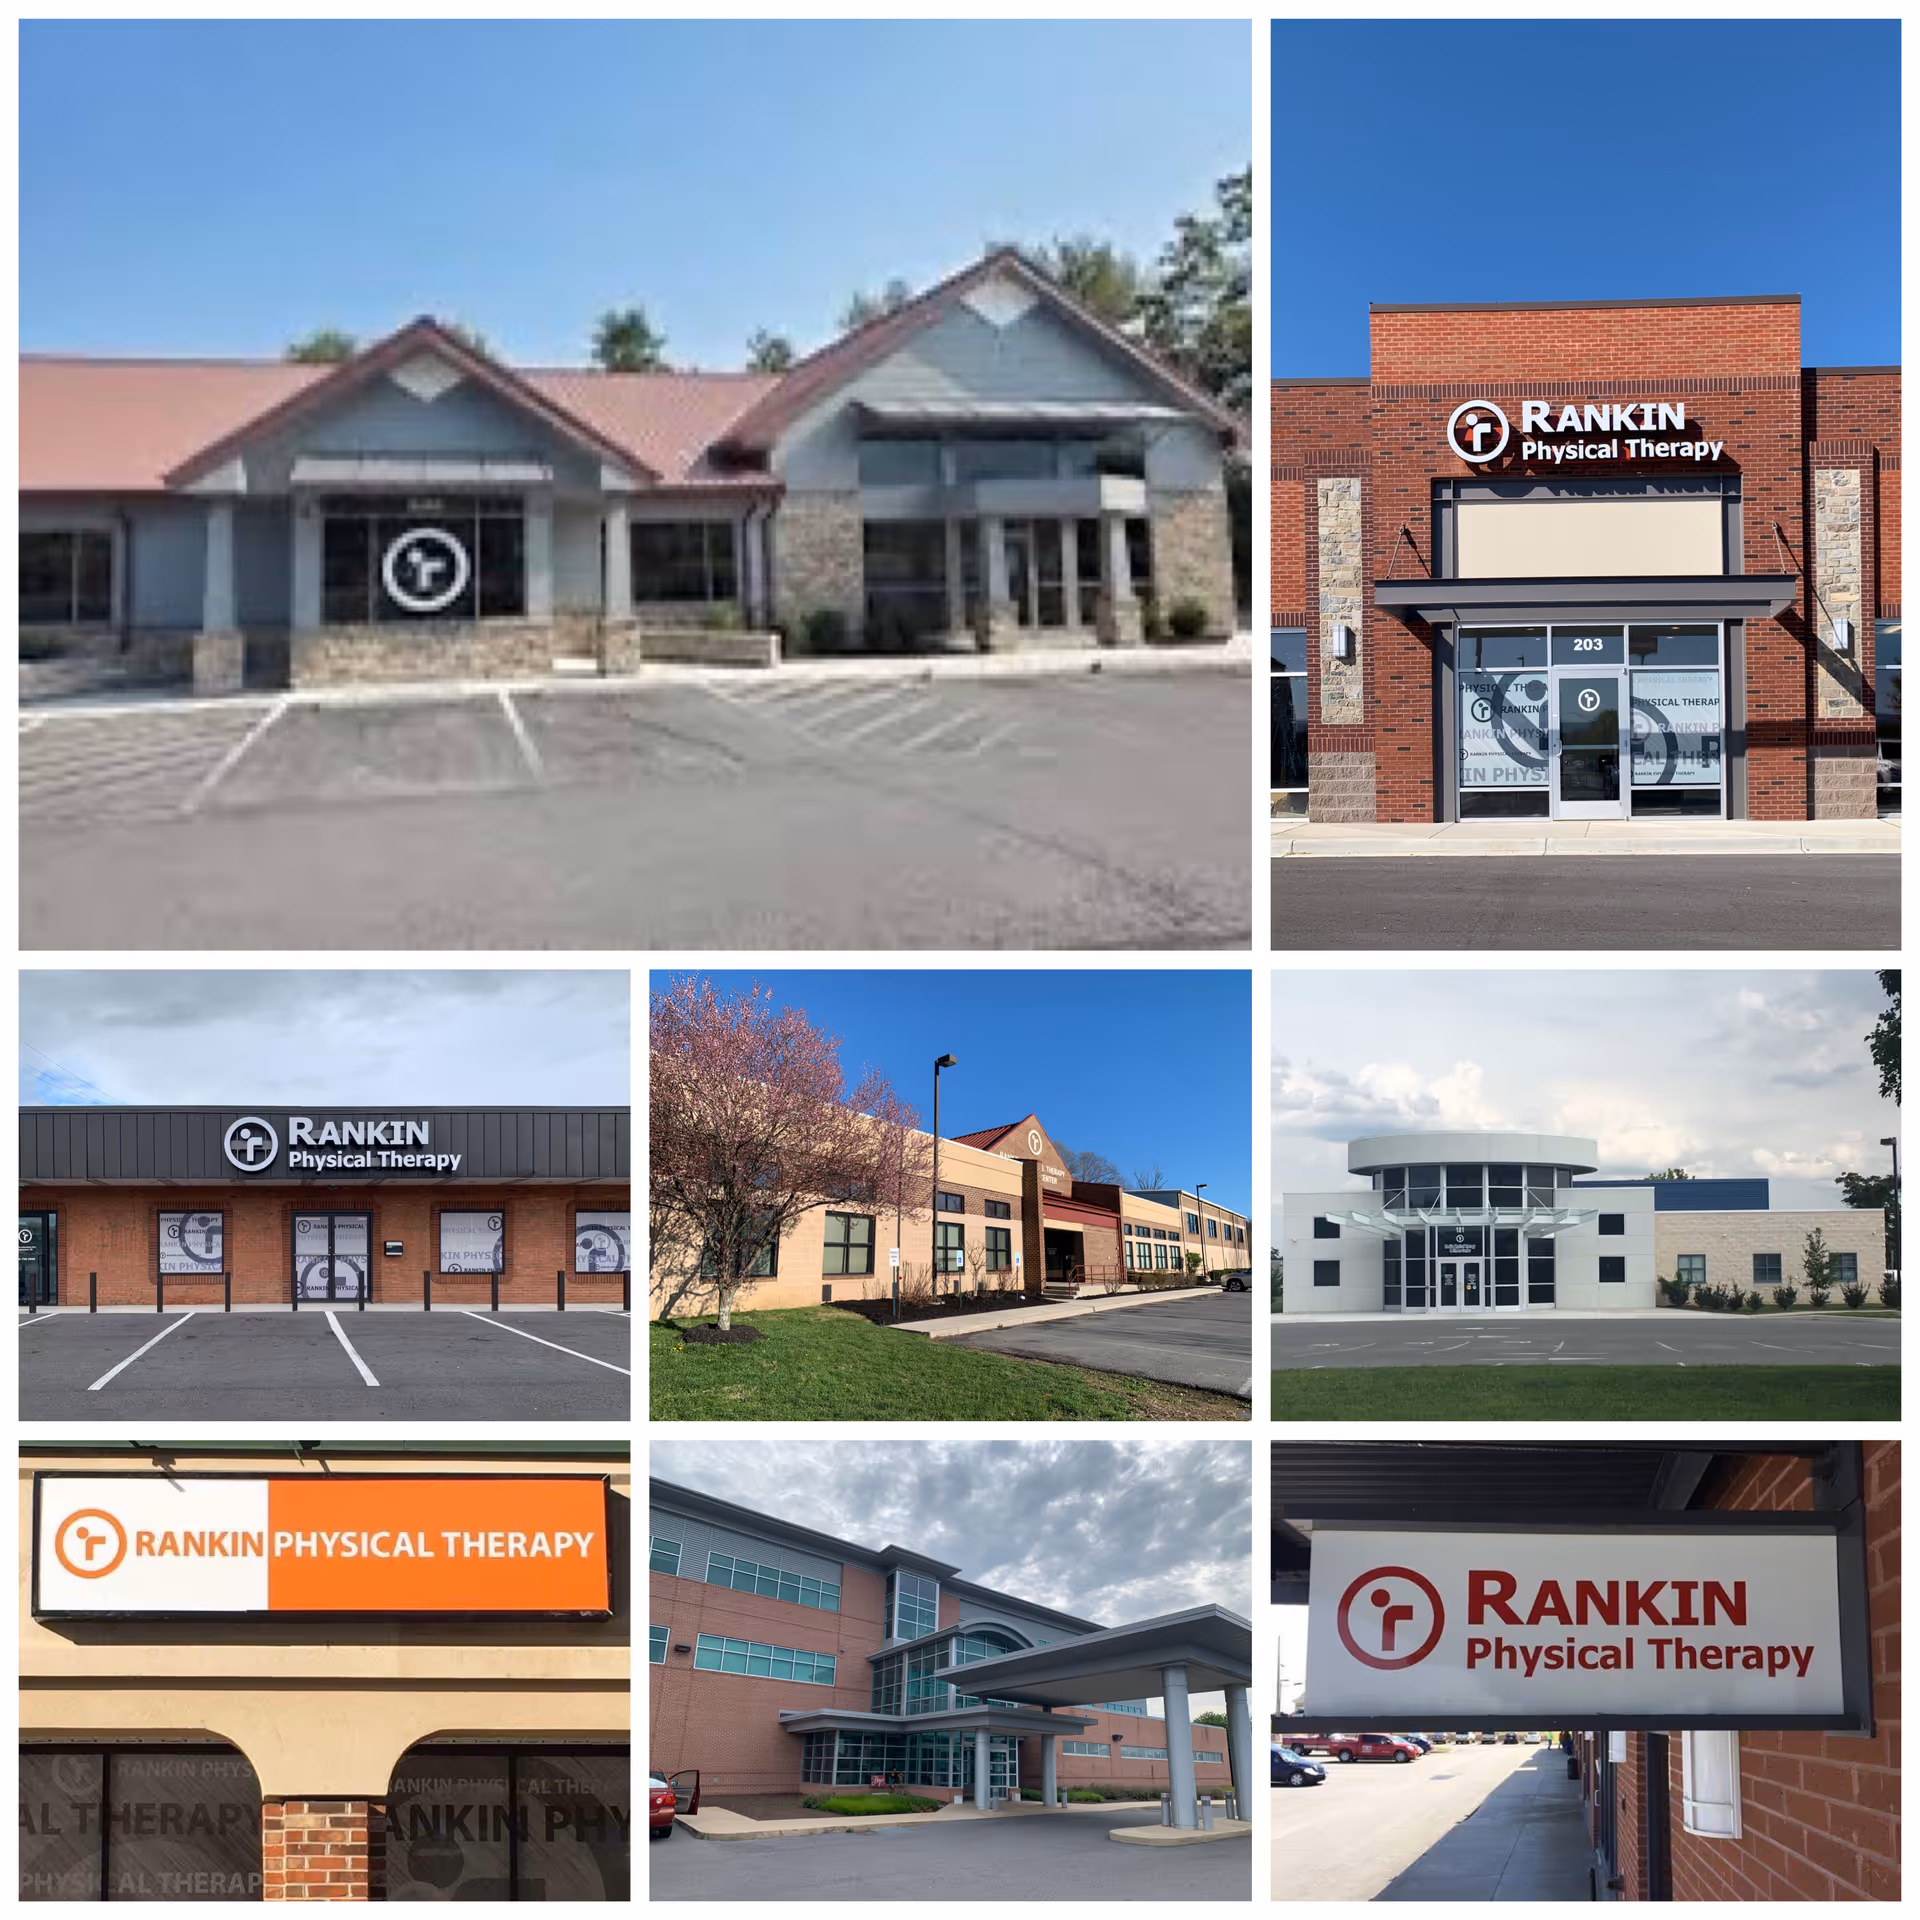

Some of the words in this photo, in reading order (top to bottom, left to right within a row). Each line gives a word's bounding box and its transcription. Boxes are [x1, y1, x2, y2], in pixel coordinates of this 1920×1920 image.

[1522, 400, 1685, 433] RANKIN
[1522, 439, 1618, 464] Physical
[1625, 438, 1724, 462] Therapy
[1573, 638, 1604, 651] 203
[1631, 698, 1680, 707] PHYSICAL
[1658, 723, 1708, 733] RANKIN
[288, 1116, 429, 1146] RANKIN
[288, 1151, 371, 1171] Physical
[377, 1151, 462, 1171] Therapy
[135, 1532, 265, 1558] RANKIN
[274, 1530, 435, 1558] PHYSICAL
[446, 1531, 596, 1559] THERAPY
[1467, 1570, 1748, 1627] RANKIN
[1467, 1637, 1635, 1678] Physical
[1648, 1637, 1815, 1678] Therapy
